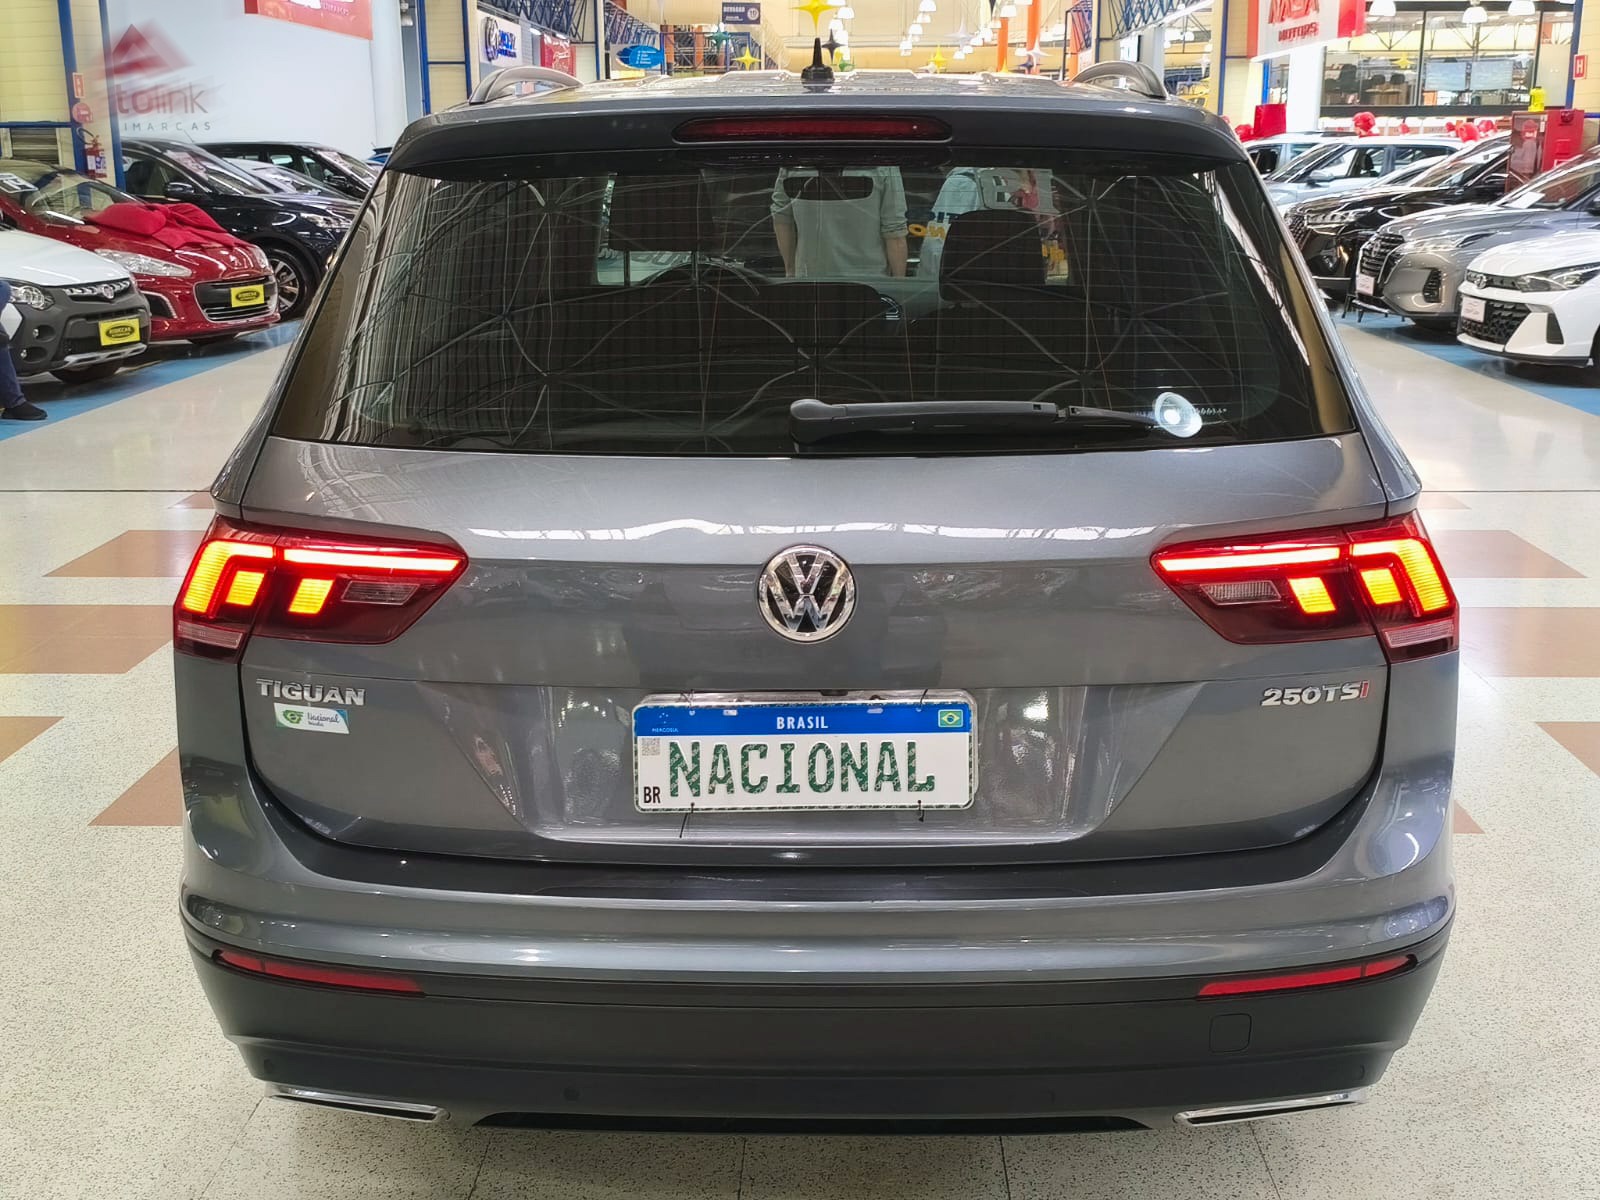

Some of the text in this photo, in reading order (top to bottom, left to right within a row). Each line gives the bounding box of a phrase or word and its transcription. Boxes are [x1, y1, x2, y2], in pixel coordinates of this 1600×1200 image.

[1576, 59, 1584, 75] H
[255, 678, 366, 706] TIGUAN
[776, 716, 829, 730] BRASIL
[669, 741, 936, 798] NACIONAL
[643, 786, 661, 804] BR
